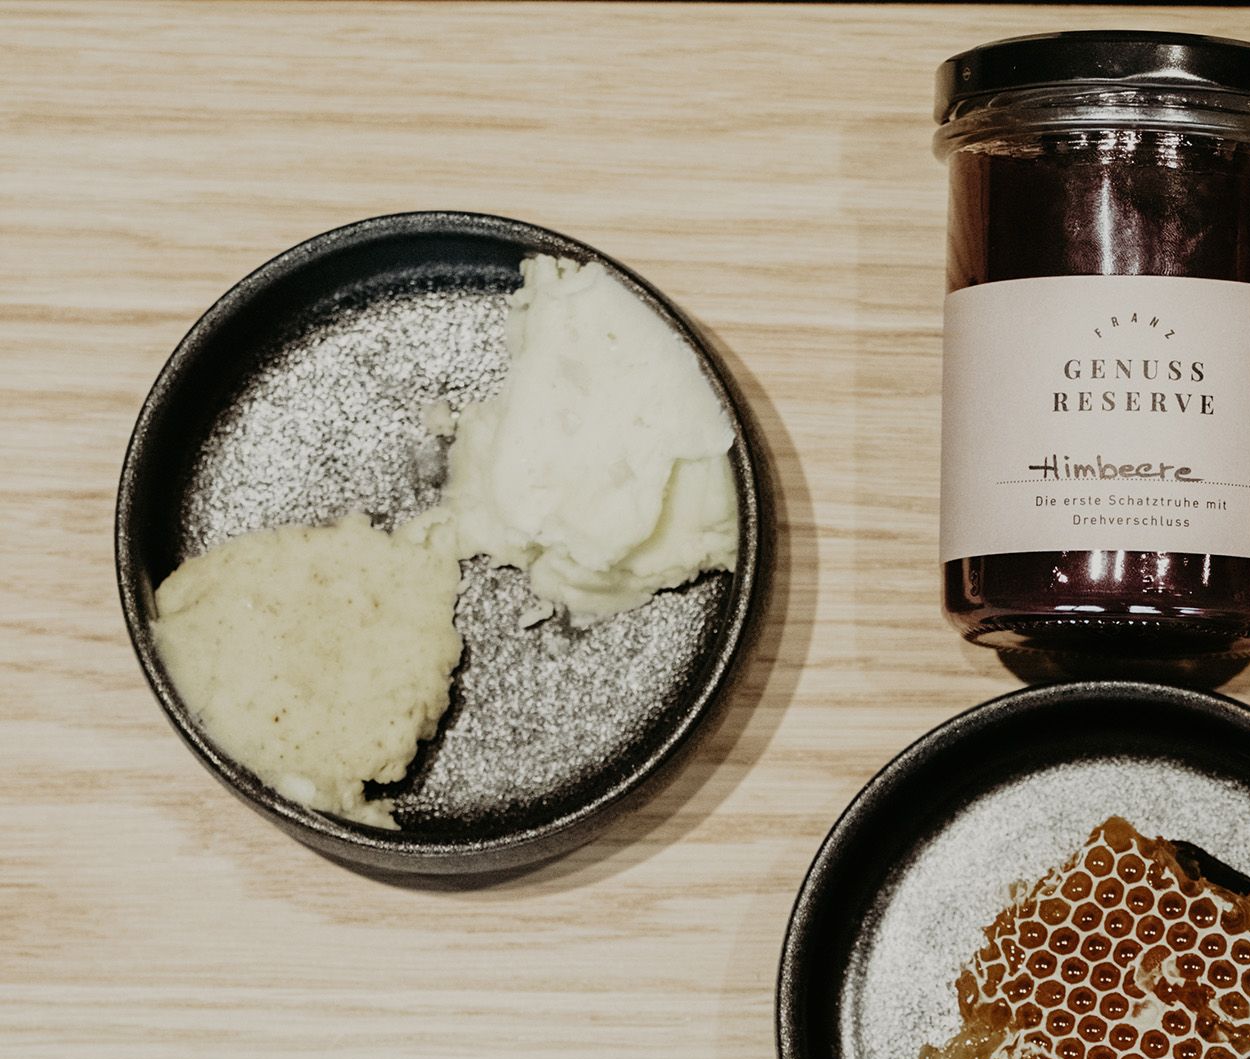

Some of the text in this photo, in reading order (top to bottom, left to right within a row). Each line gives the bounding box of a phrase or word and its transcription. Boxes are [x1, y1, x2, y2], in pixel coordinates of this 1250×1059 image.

[1094, 312, 1176, 339] FRANZ
[1063, 359, 1205, 382] GENUSS
[1053, 391, 1215, 415] RESERVE
[1029, 454, 1204, 481] Himbeere
[1035, 494, 1228, 511] Die erste Schatztruhe mit
[1072, 514, 1190, 528] Drehverschluss
